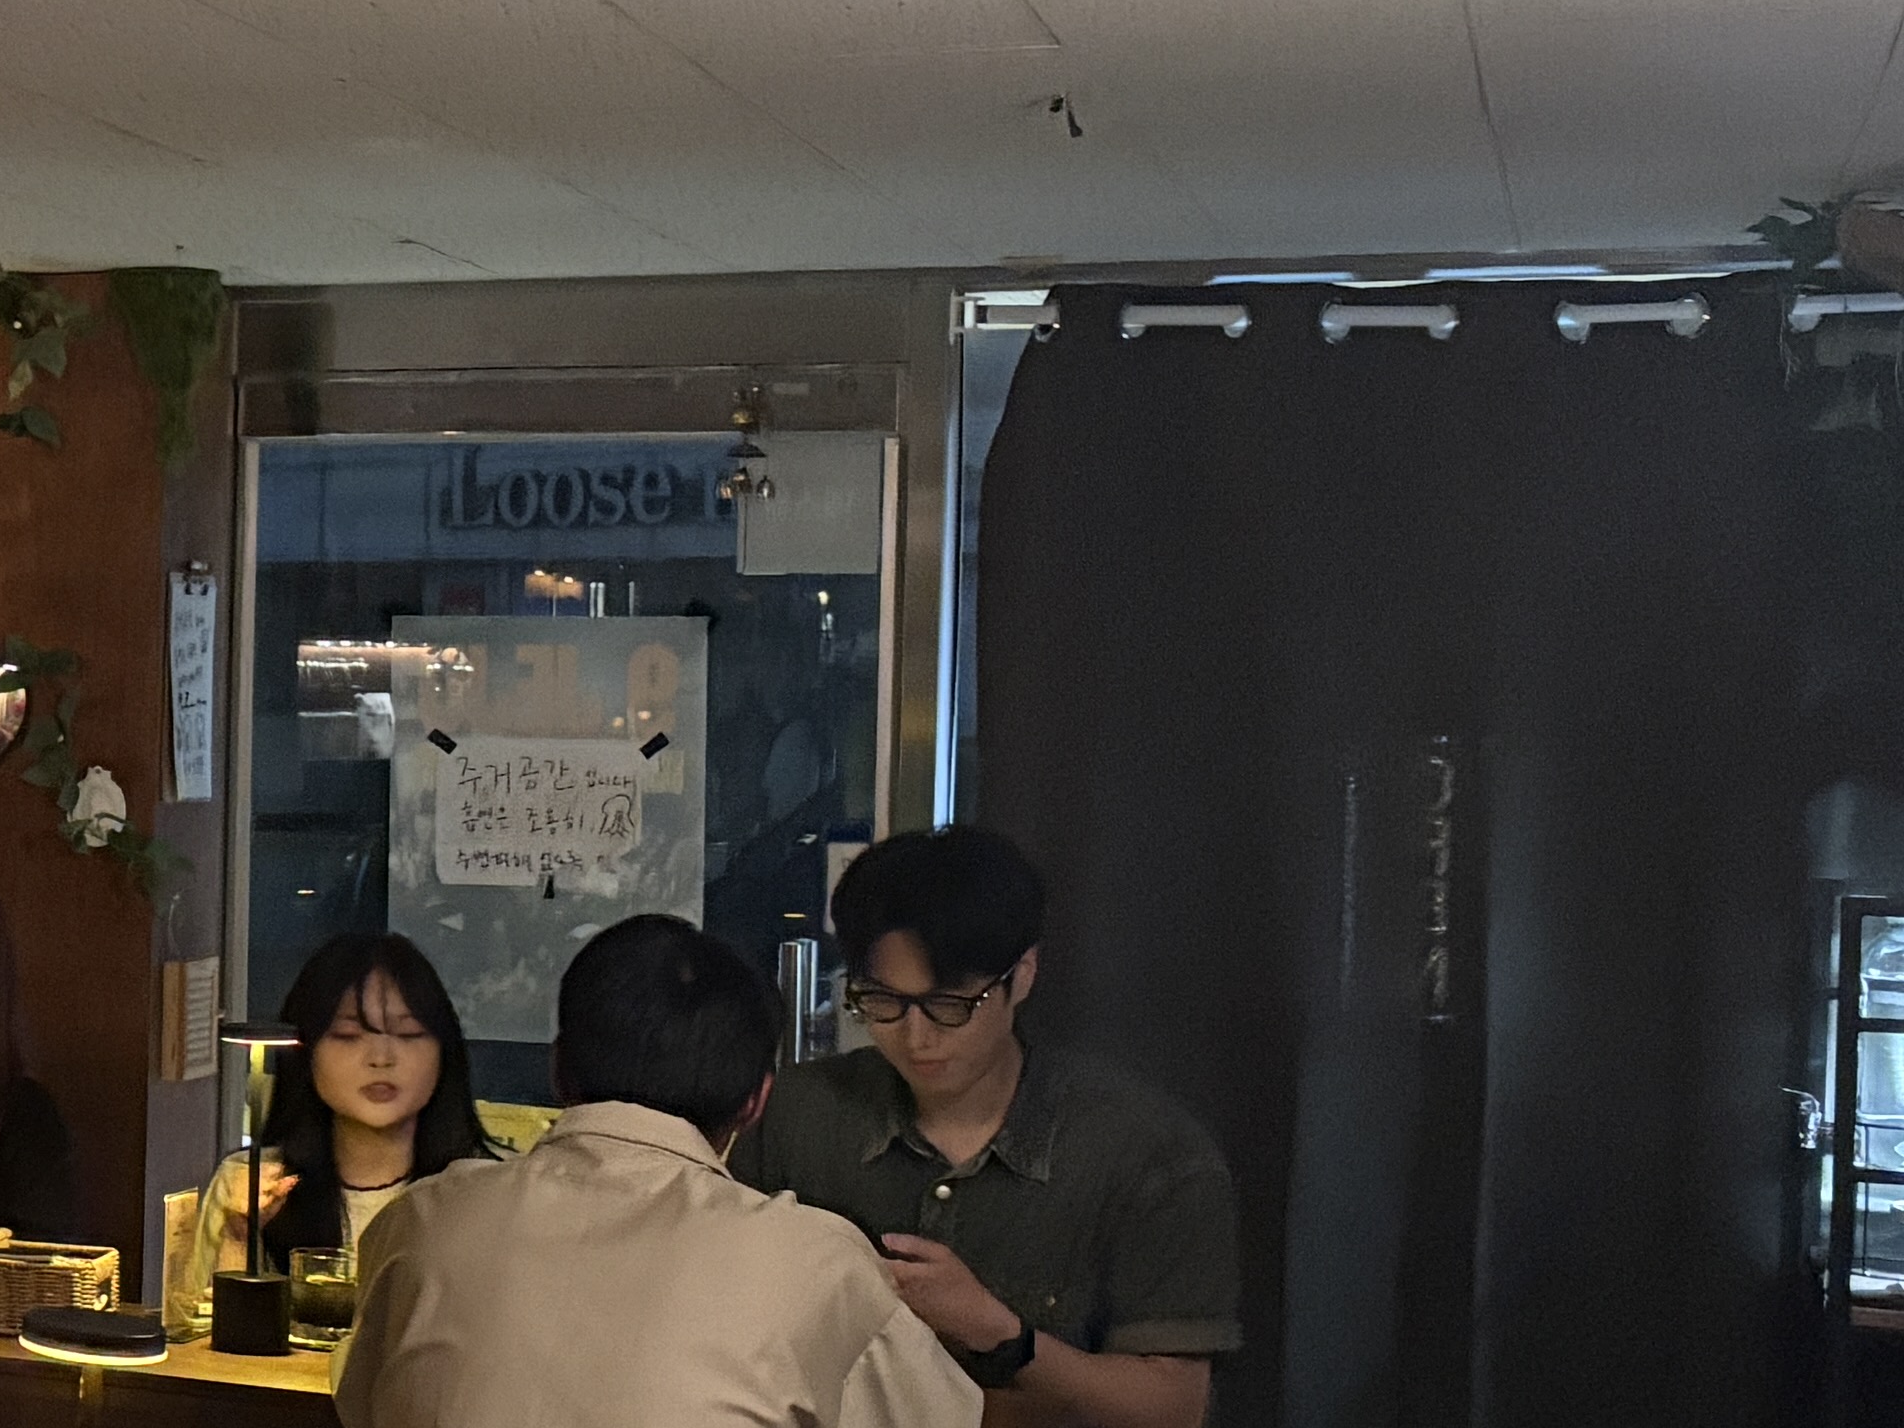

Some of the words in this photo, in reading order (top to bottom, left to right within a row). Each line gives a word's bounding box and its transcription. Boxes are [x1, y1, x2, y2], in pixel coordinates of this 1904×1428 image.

[446, 445, 674, 527] Loose
[456, 756, 574, 794] 주거공간
[586, 770, 634, 788] 입니다
[462, 801, 509, 832] 흡연은
